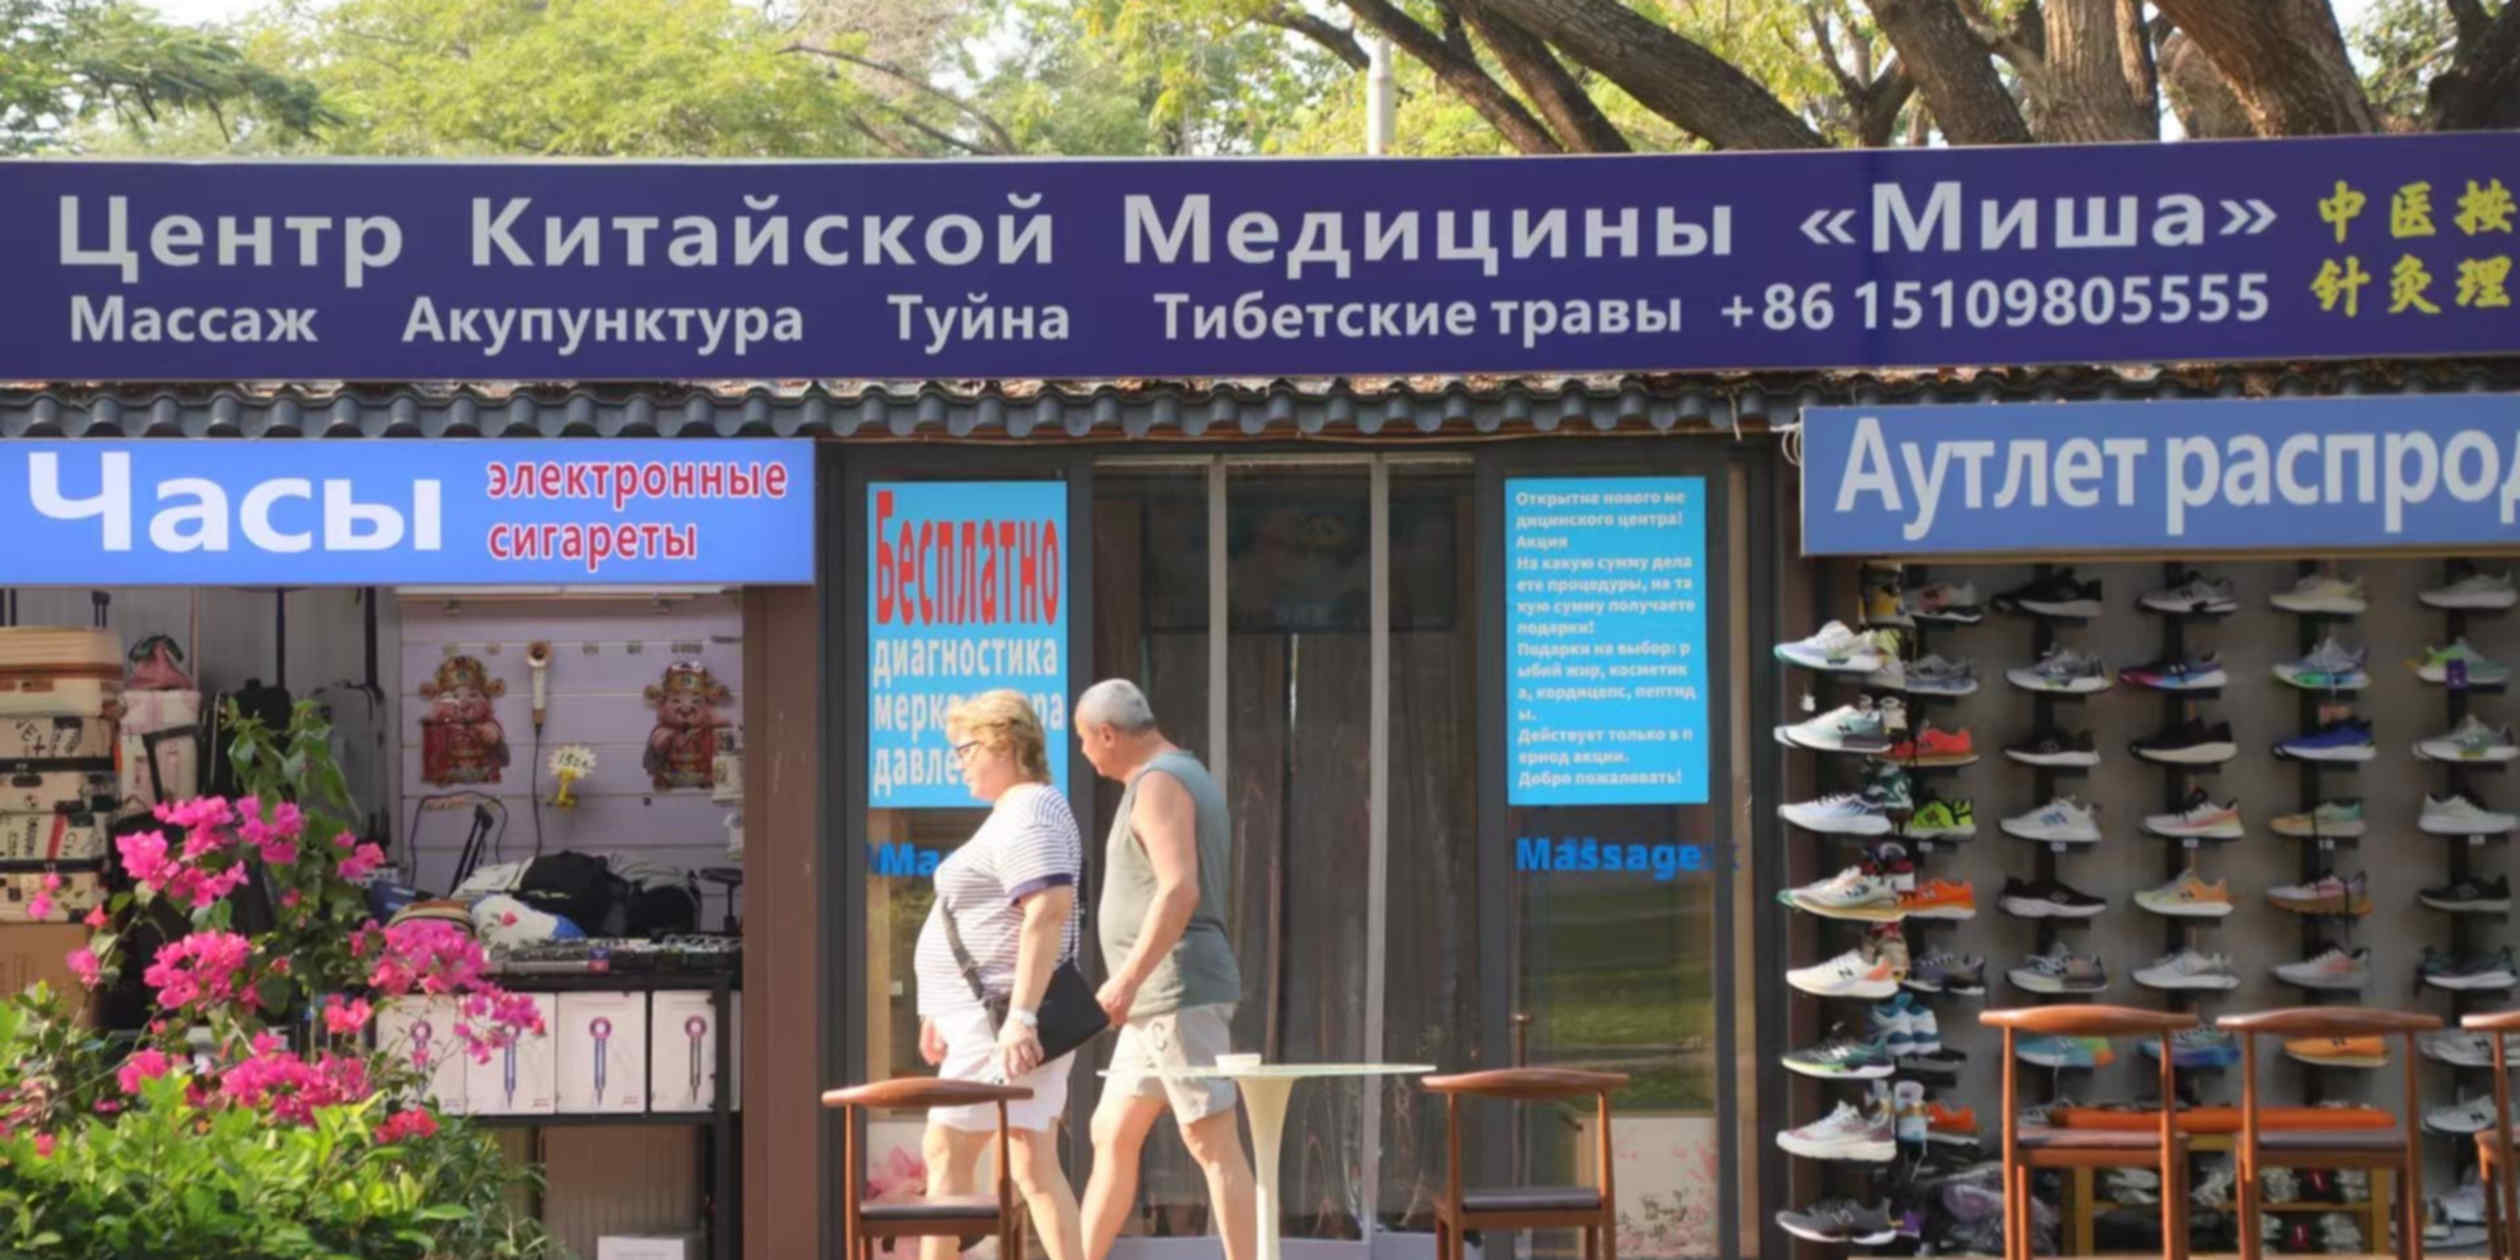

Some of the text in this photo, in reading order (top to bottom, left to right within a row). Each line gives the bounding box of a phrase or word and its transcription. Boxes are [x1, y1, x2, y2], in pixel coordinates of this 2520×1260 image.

[2317, 178, 2517, 244] 中医按
[60, 180, 2279, 288] Центр Китайской Медицины «Миша»
[2310, 253, 2513, 318] 针灸理
[70, 272, 2270, 356] Массаж Акупунктура Туйна Тибетские травы +86 15109805555
[486, 459, 788, 509] электронные
[1835, 415, 2148, 541] Аутлет
[28, 450, 442, 552] Часы
[1515, 491, 1600, 508] Открытие
[1603, 490, 1661, 505] нового
[1515, 510, 1683, 530] дицинского центра!
[487, 518, 698, 570] сигареты
[1515, 535, 1569, 551] Акция
[875, 488, 1060, 626] Бесплатно
[1516, 555, 1693, 573] На какую сумму дела
[1553, 601, 1605, 616] сумму
[1608, 599, 1696, 615] получаете
[1516, 620, 1596, 637] подарки!
[1517, 642, 1591, 659] Подарки
[873, 637, 1058, 688] диагностика
[1609, 664, 1689, 678] косметик
[1536, 686, 1633, 703] кордицепс,
[1517, 726, 1605, 745] Действует
[1608, 728, 1666, 743] только
[1518, 751, 1630, 766] ериод акции.
[1517, 768, 1683, 789] Добро пожаловать!
[1515, 836, 1702, 881] Massage
